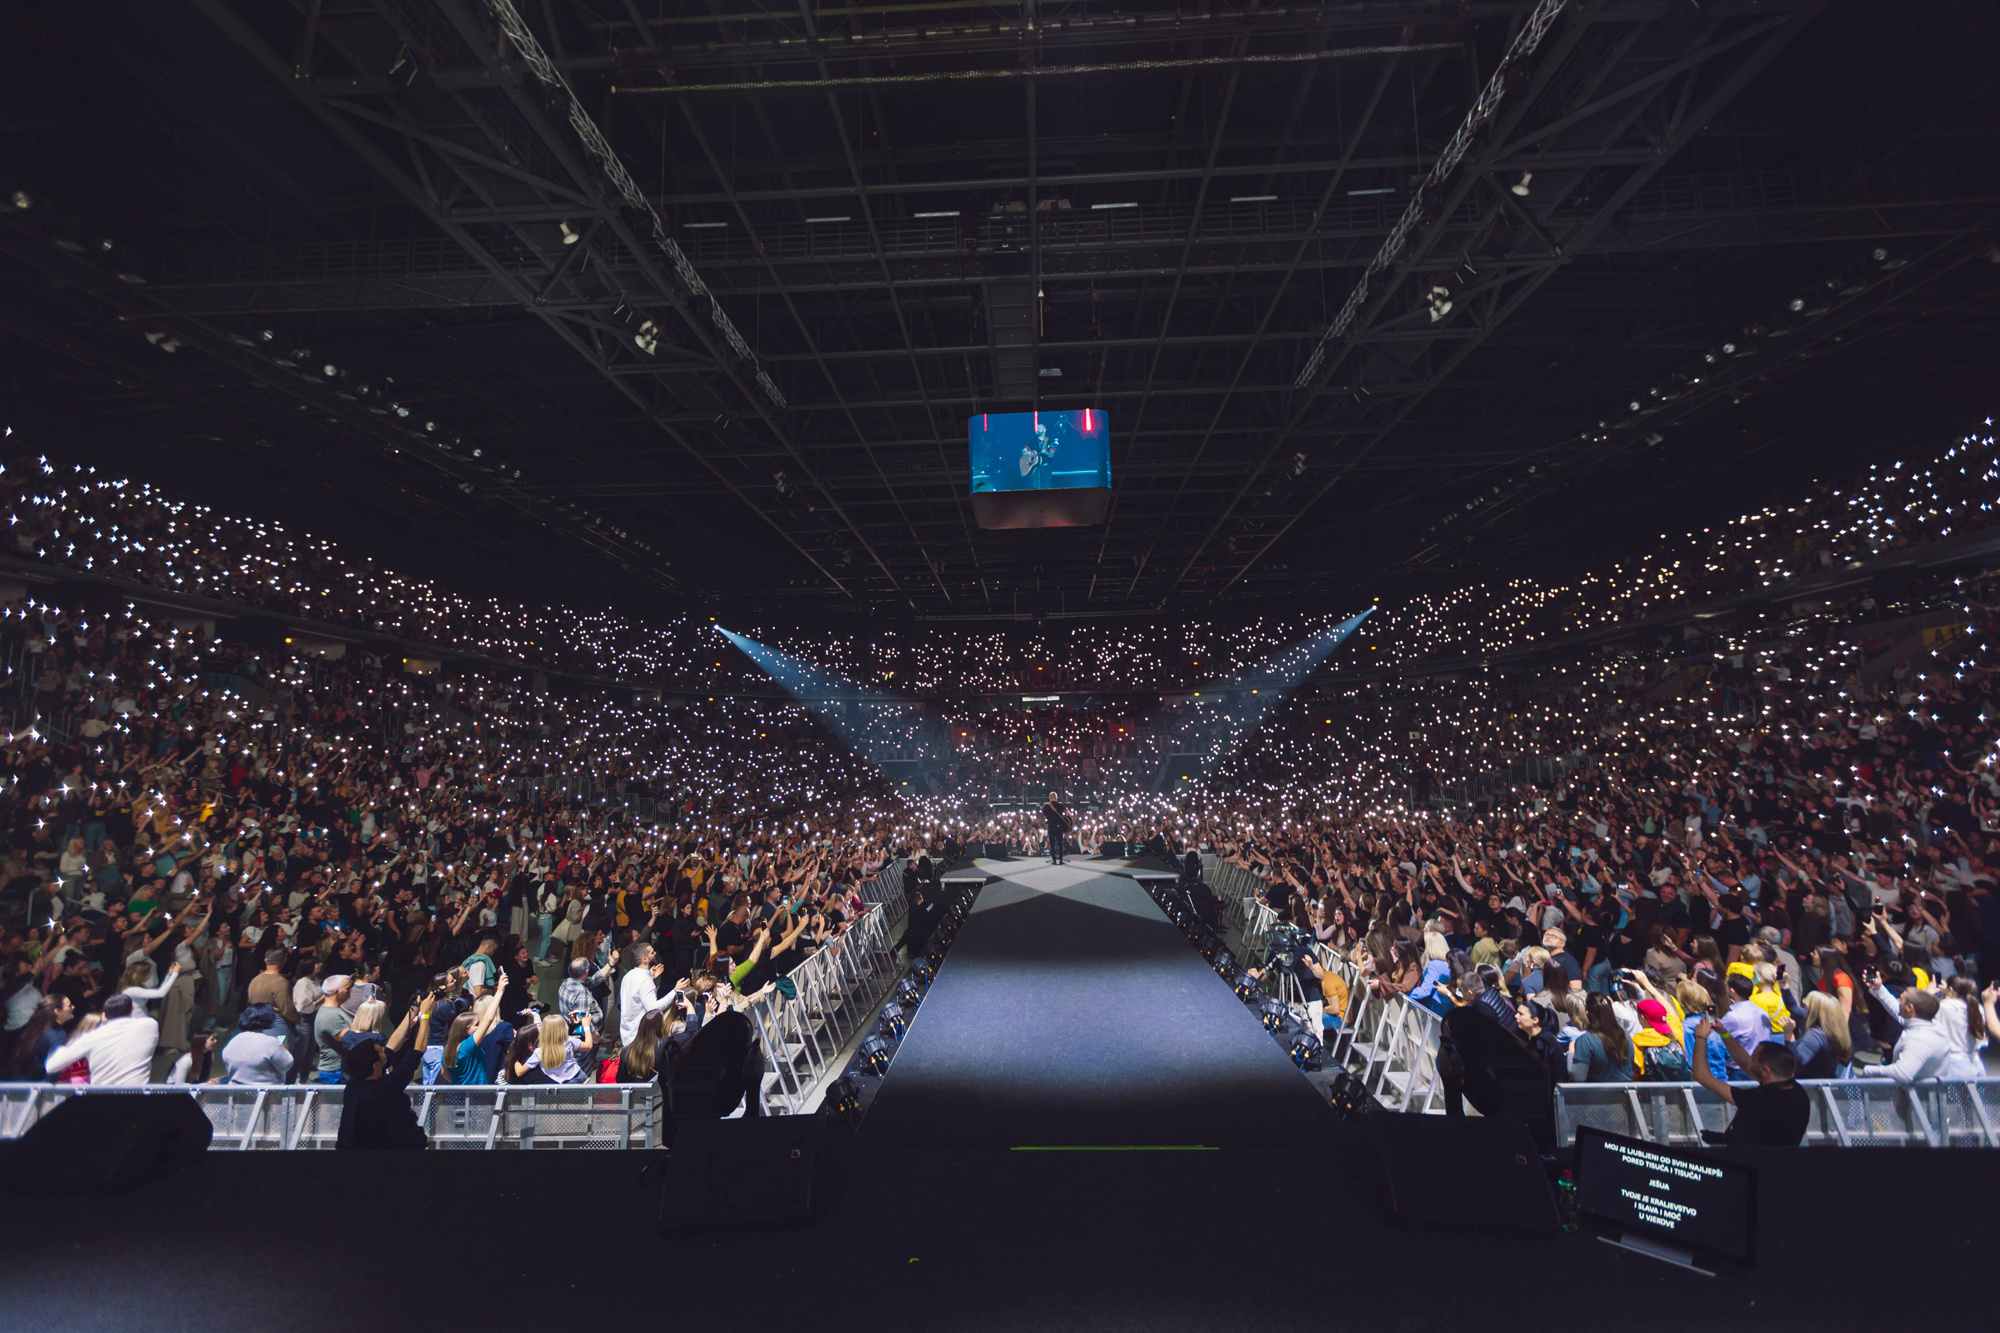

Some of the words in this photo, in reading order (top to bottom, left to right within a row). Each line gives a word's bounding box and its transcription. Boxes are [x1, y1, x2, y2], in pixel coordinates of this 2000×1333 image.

[1604, 1142, 1618, 1152] MOJ
[1619, 1145, 1626, 1153] JE
[1627, 1147, 1659, 1162] LJUBLJENI
[1660, 1155, 1671, 1164] OD
[1672, 1158, 1687, 1168] SVIH
[1689, 1163, 1723, 1178] NAJLJEPŠI
[1622, 1154, 1645, 1166] PORED
[1645, 1160, 1669, 1173] TISUĆA
[1649, 1179, 1670, 1191] JEŠUA
[1621, 1188, 1642, 1201] TVOJE
[1642, 1195, 1649, 1203] JE
[1650, 1196, 1697, 1217] KRALJEVSTVO
[1637, 1202, 1659, 1215] SLAVA
[1639, 1211, 1645, 1220] U
[1645, 1213, 1675, 1229] VJEKOVE
